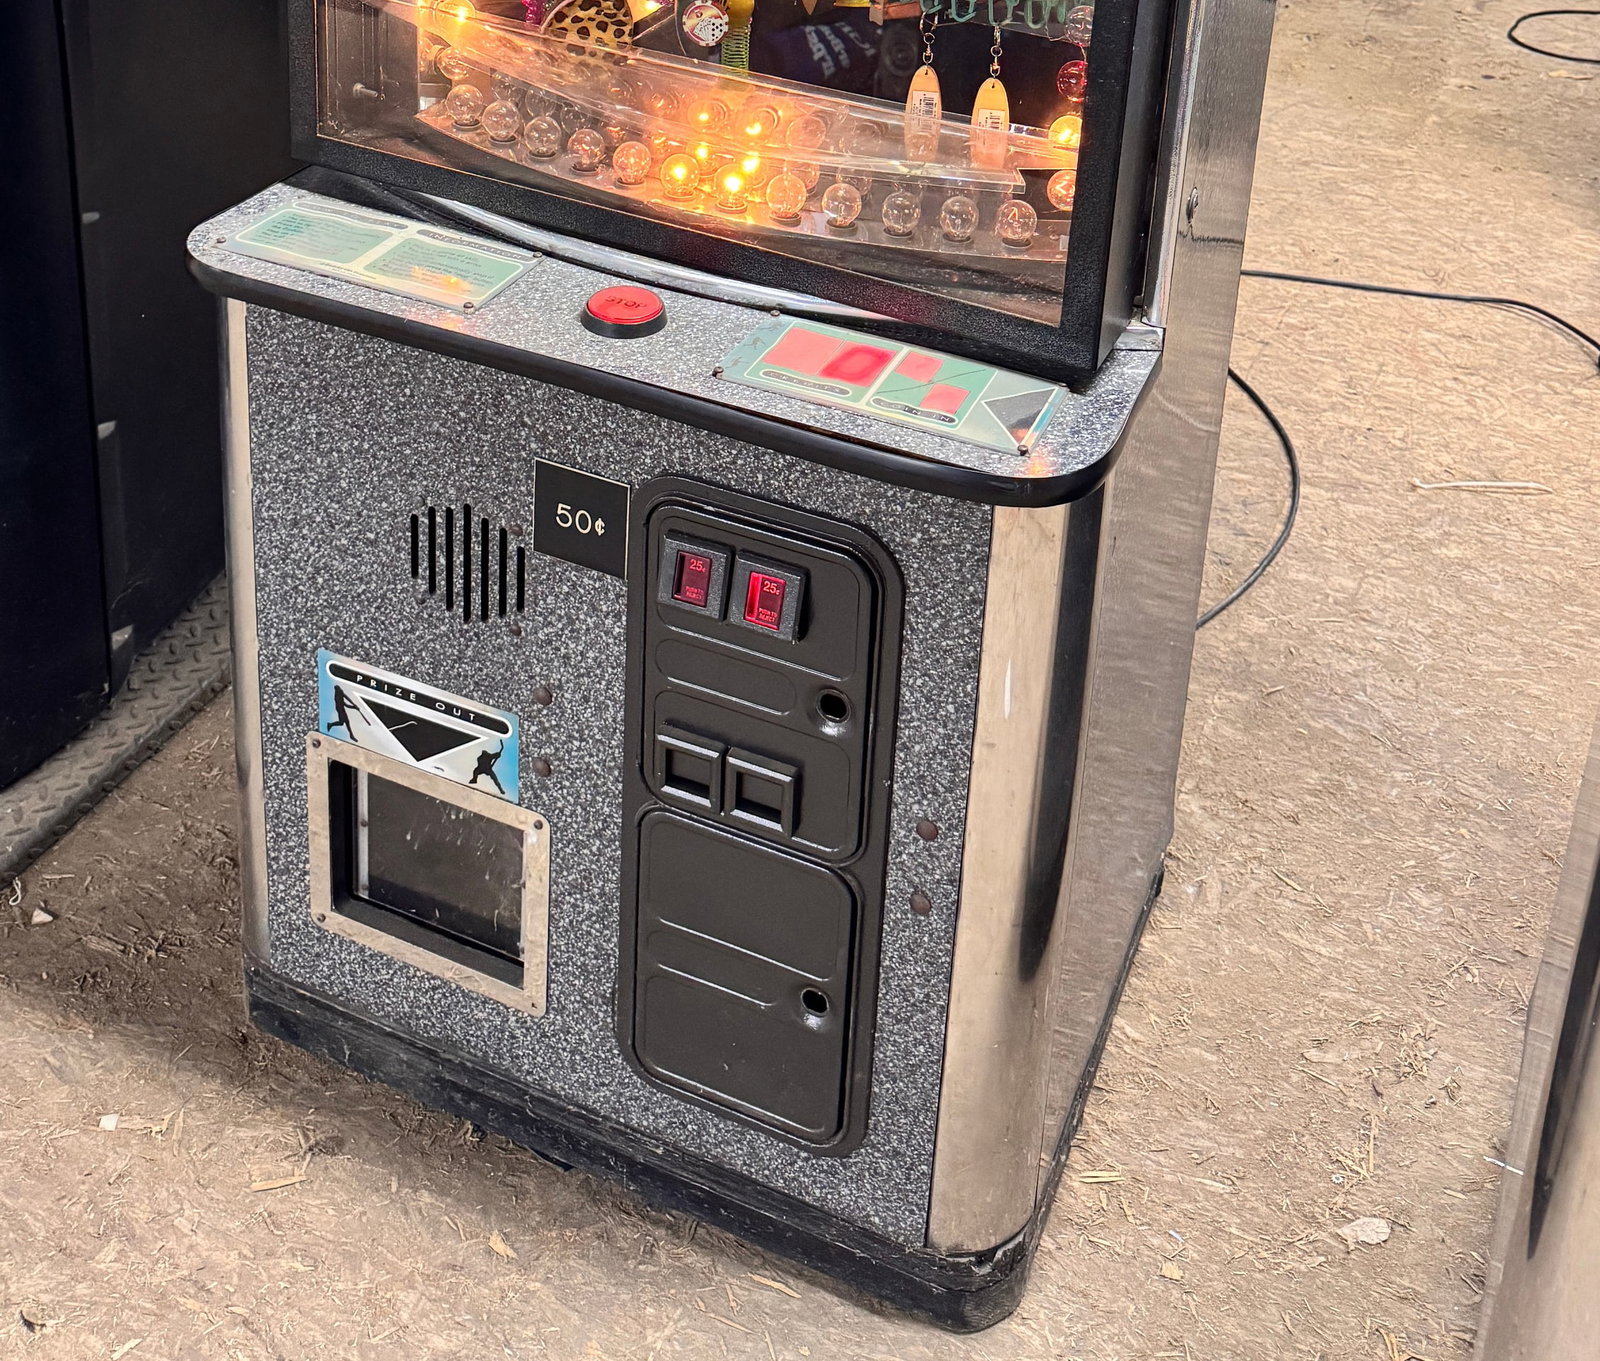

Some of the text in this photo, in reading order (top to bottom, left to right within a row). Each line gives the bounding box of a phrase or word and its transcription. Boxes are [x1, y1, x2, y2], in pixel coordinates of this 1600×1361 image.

[429, 232, 522, 259] INFORMATION
[604, 296, 648, 309] STOP
[555, 502, 605, 536] 50¢
[356, 674, 476, 722] PRIZE OUT
